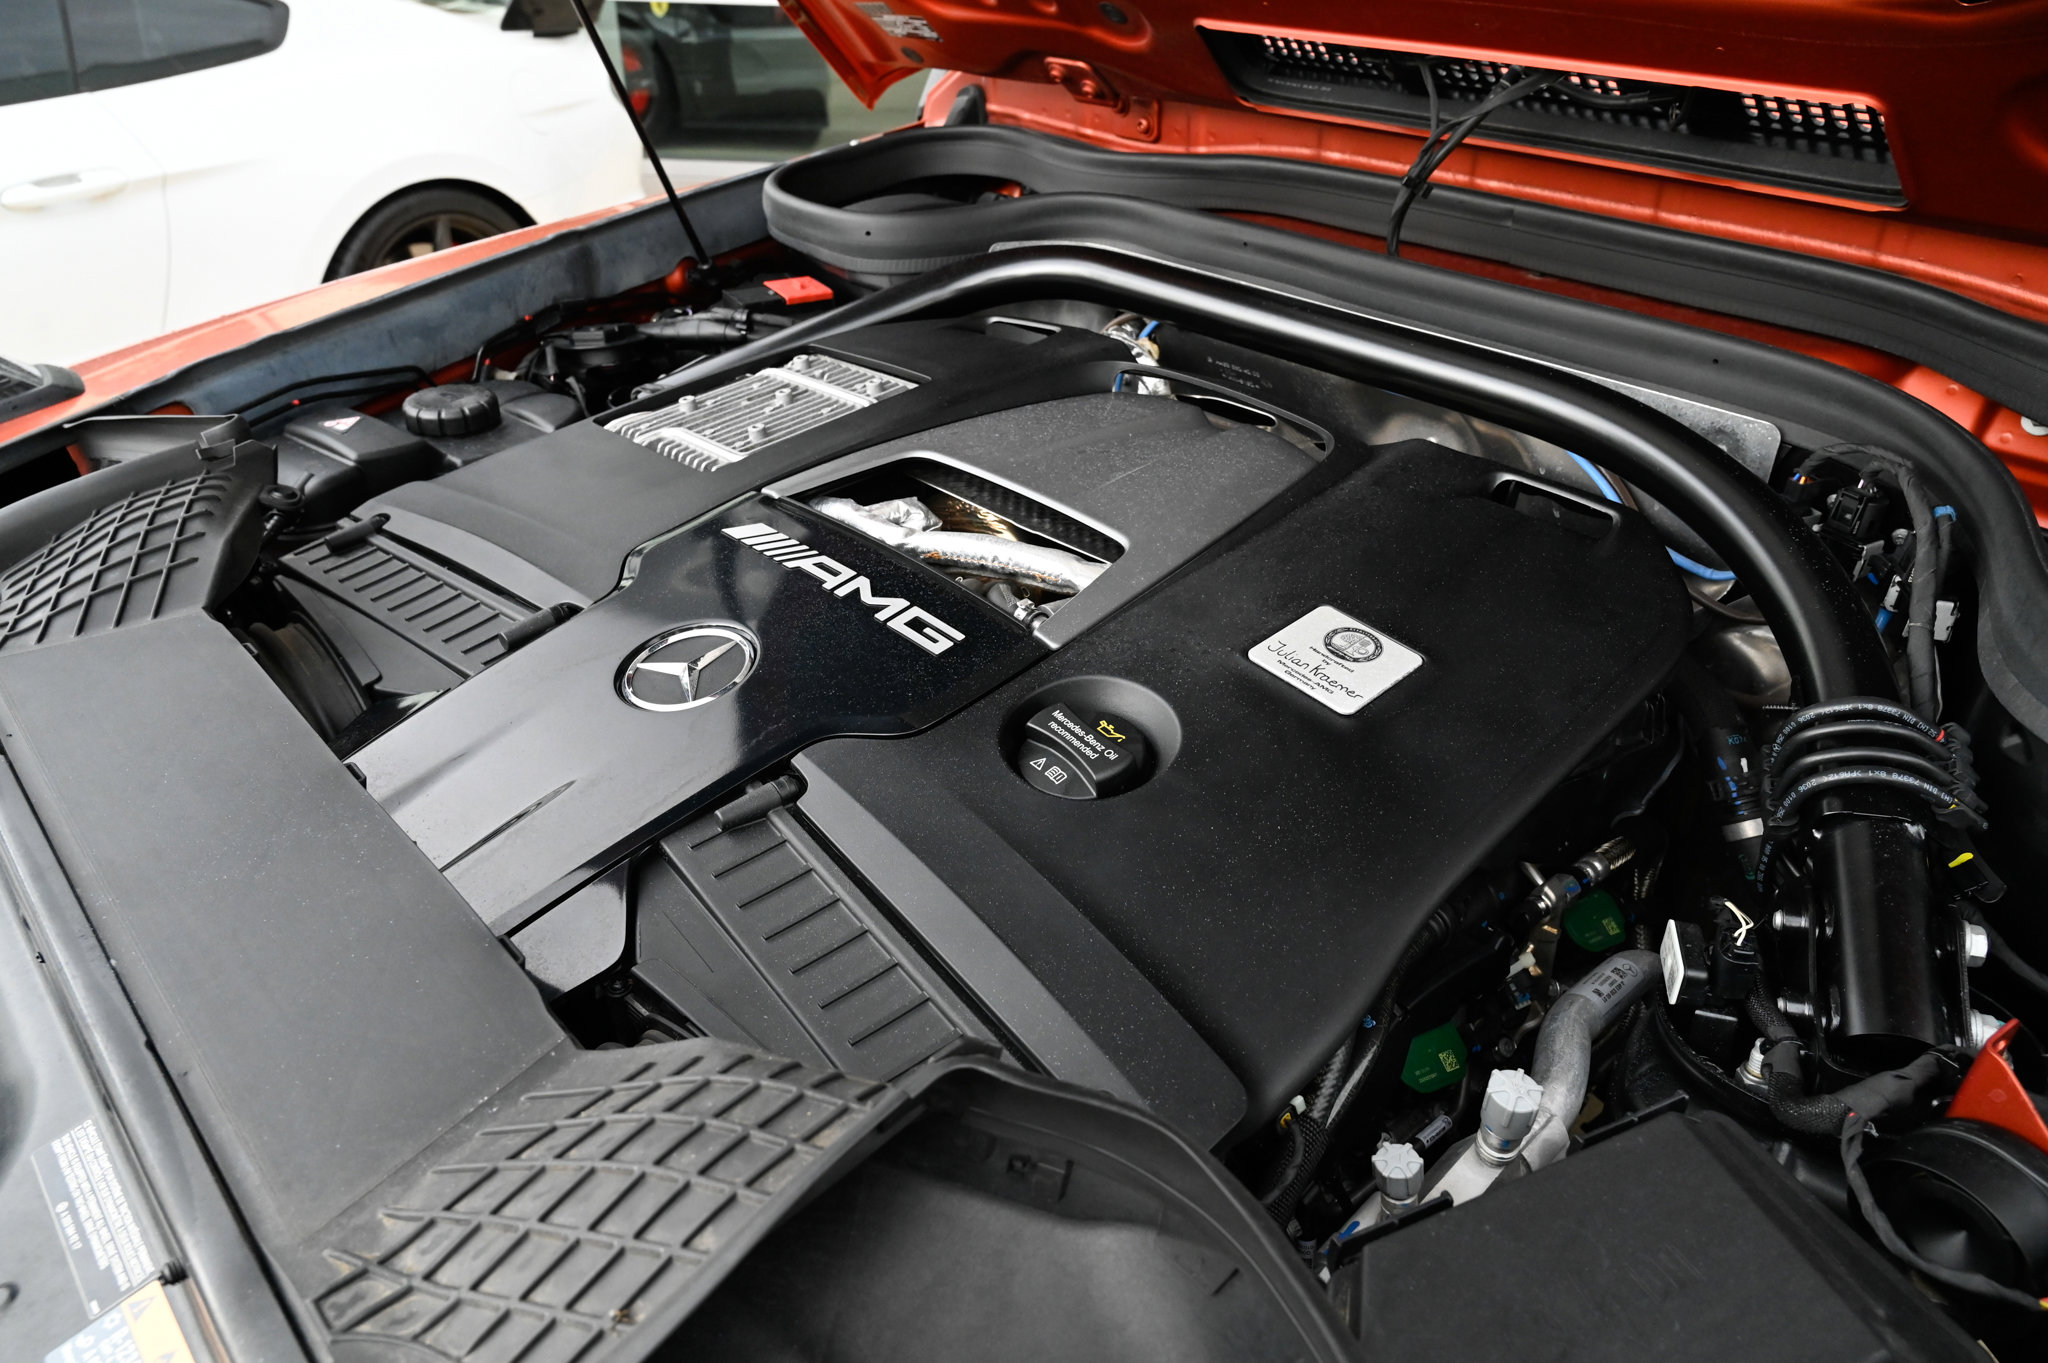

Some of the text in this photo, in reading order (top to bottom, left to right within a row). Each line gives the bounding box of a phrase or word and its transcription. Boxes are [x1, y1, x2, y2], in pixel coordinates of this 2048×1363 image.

[782, 555, 966, 656] AMG
[1267, 640, 1310, 670] Julian
[1309, 664, 1364, 699] Kraemer
[1309, 646, 1355, 673] Handcrafted
[1277, 659, 1334, 695] Mercedes-AMG
[1284, 669, 1317, 691] Germany
[1052, 709, 1119, 761] Mercedes-Benz Oil
[1902, 713, 1915, 726] DIN
[1048, 721, 1100, 760] recommended
[1892, 772, 1920, 786] 73378
[1923, 783, 1938, 796] DIN
